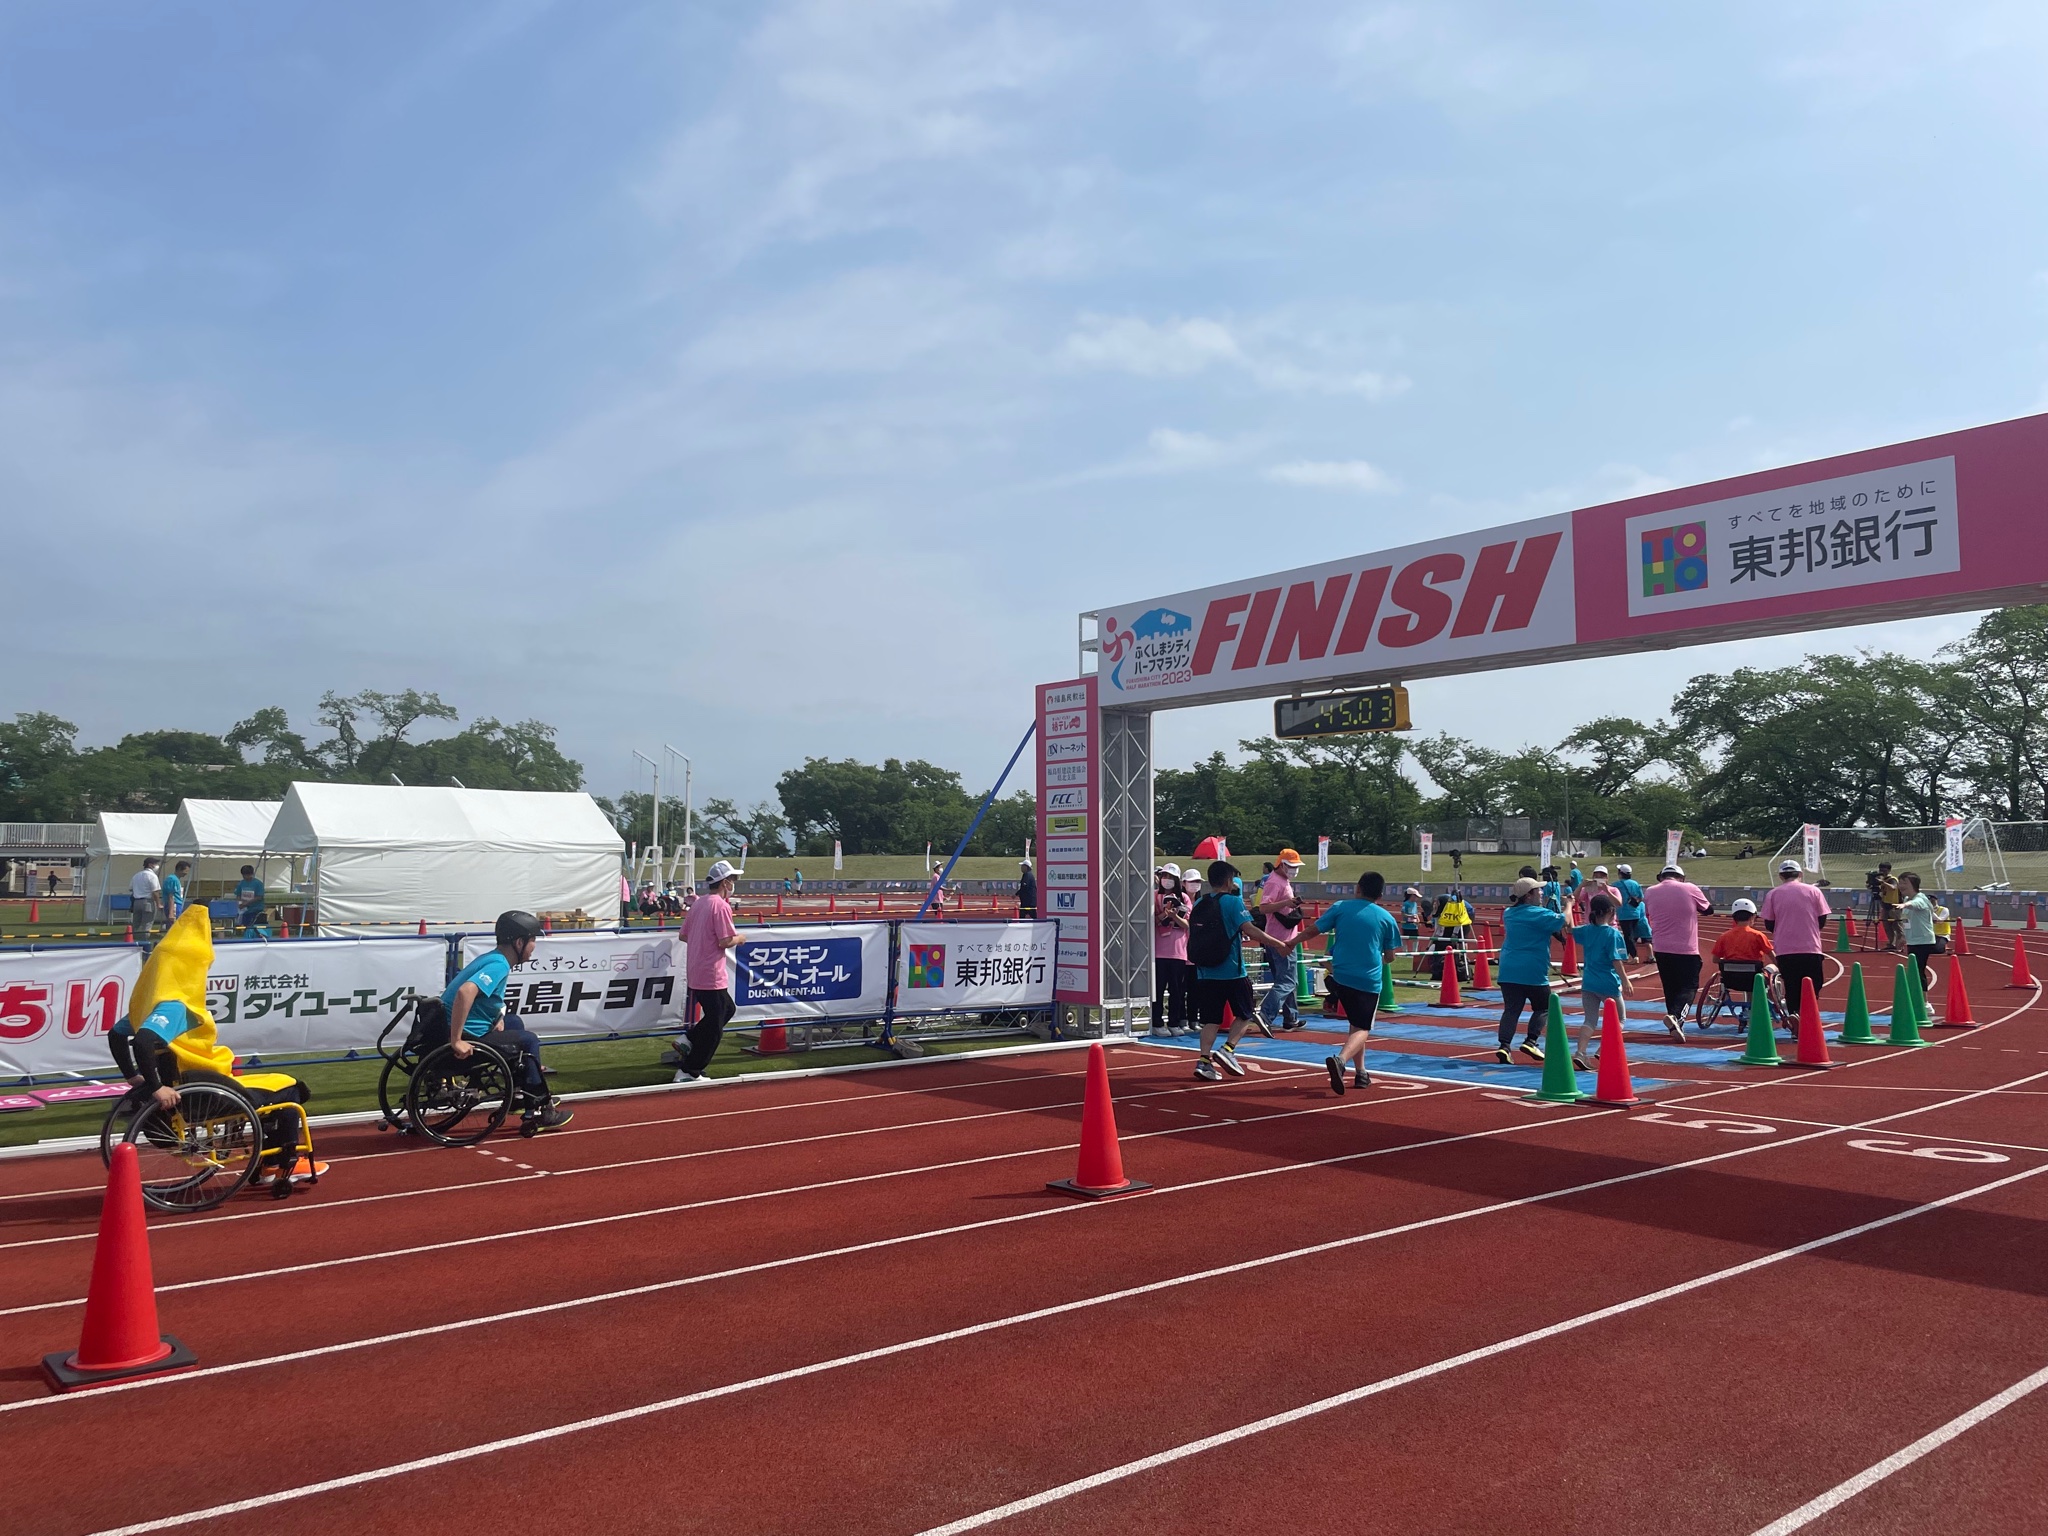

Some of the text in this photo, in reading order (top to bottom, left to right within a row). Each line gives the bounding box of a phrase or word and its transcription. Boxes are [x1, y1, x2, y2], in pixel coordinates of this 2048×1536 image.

[1728, 479, 1937, 530] すべてを地域のために
[1729, 506, 1938, 585] 東邦銀行
[1191, 531, 1564, 676] FINISH
[1134, 639, 1191, 659] ふくしまシティ
[1134, 654, 1190, 675] ハーフマラソン
[1161, 669, 1192, 686] 2023
[1059, 742, 1086, 754] トーネット
[748, 945, 829, 967] ダスキン
[957, 942, 1047, 953] すべてを地域のために
[243, 973, 309, 991] 株式会社
[955, 956, 1046, 988] 東邦銀行
[505, 976, 674, 1015] 福島トヨタ
[747, 985, 826, 999] DUSKIN RENT-ALL
[1626, 1112, 1777, 1135] 5
[1846, 1139, 2011, 1164] 6
